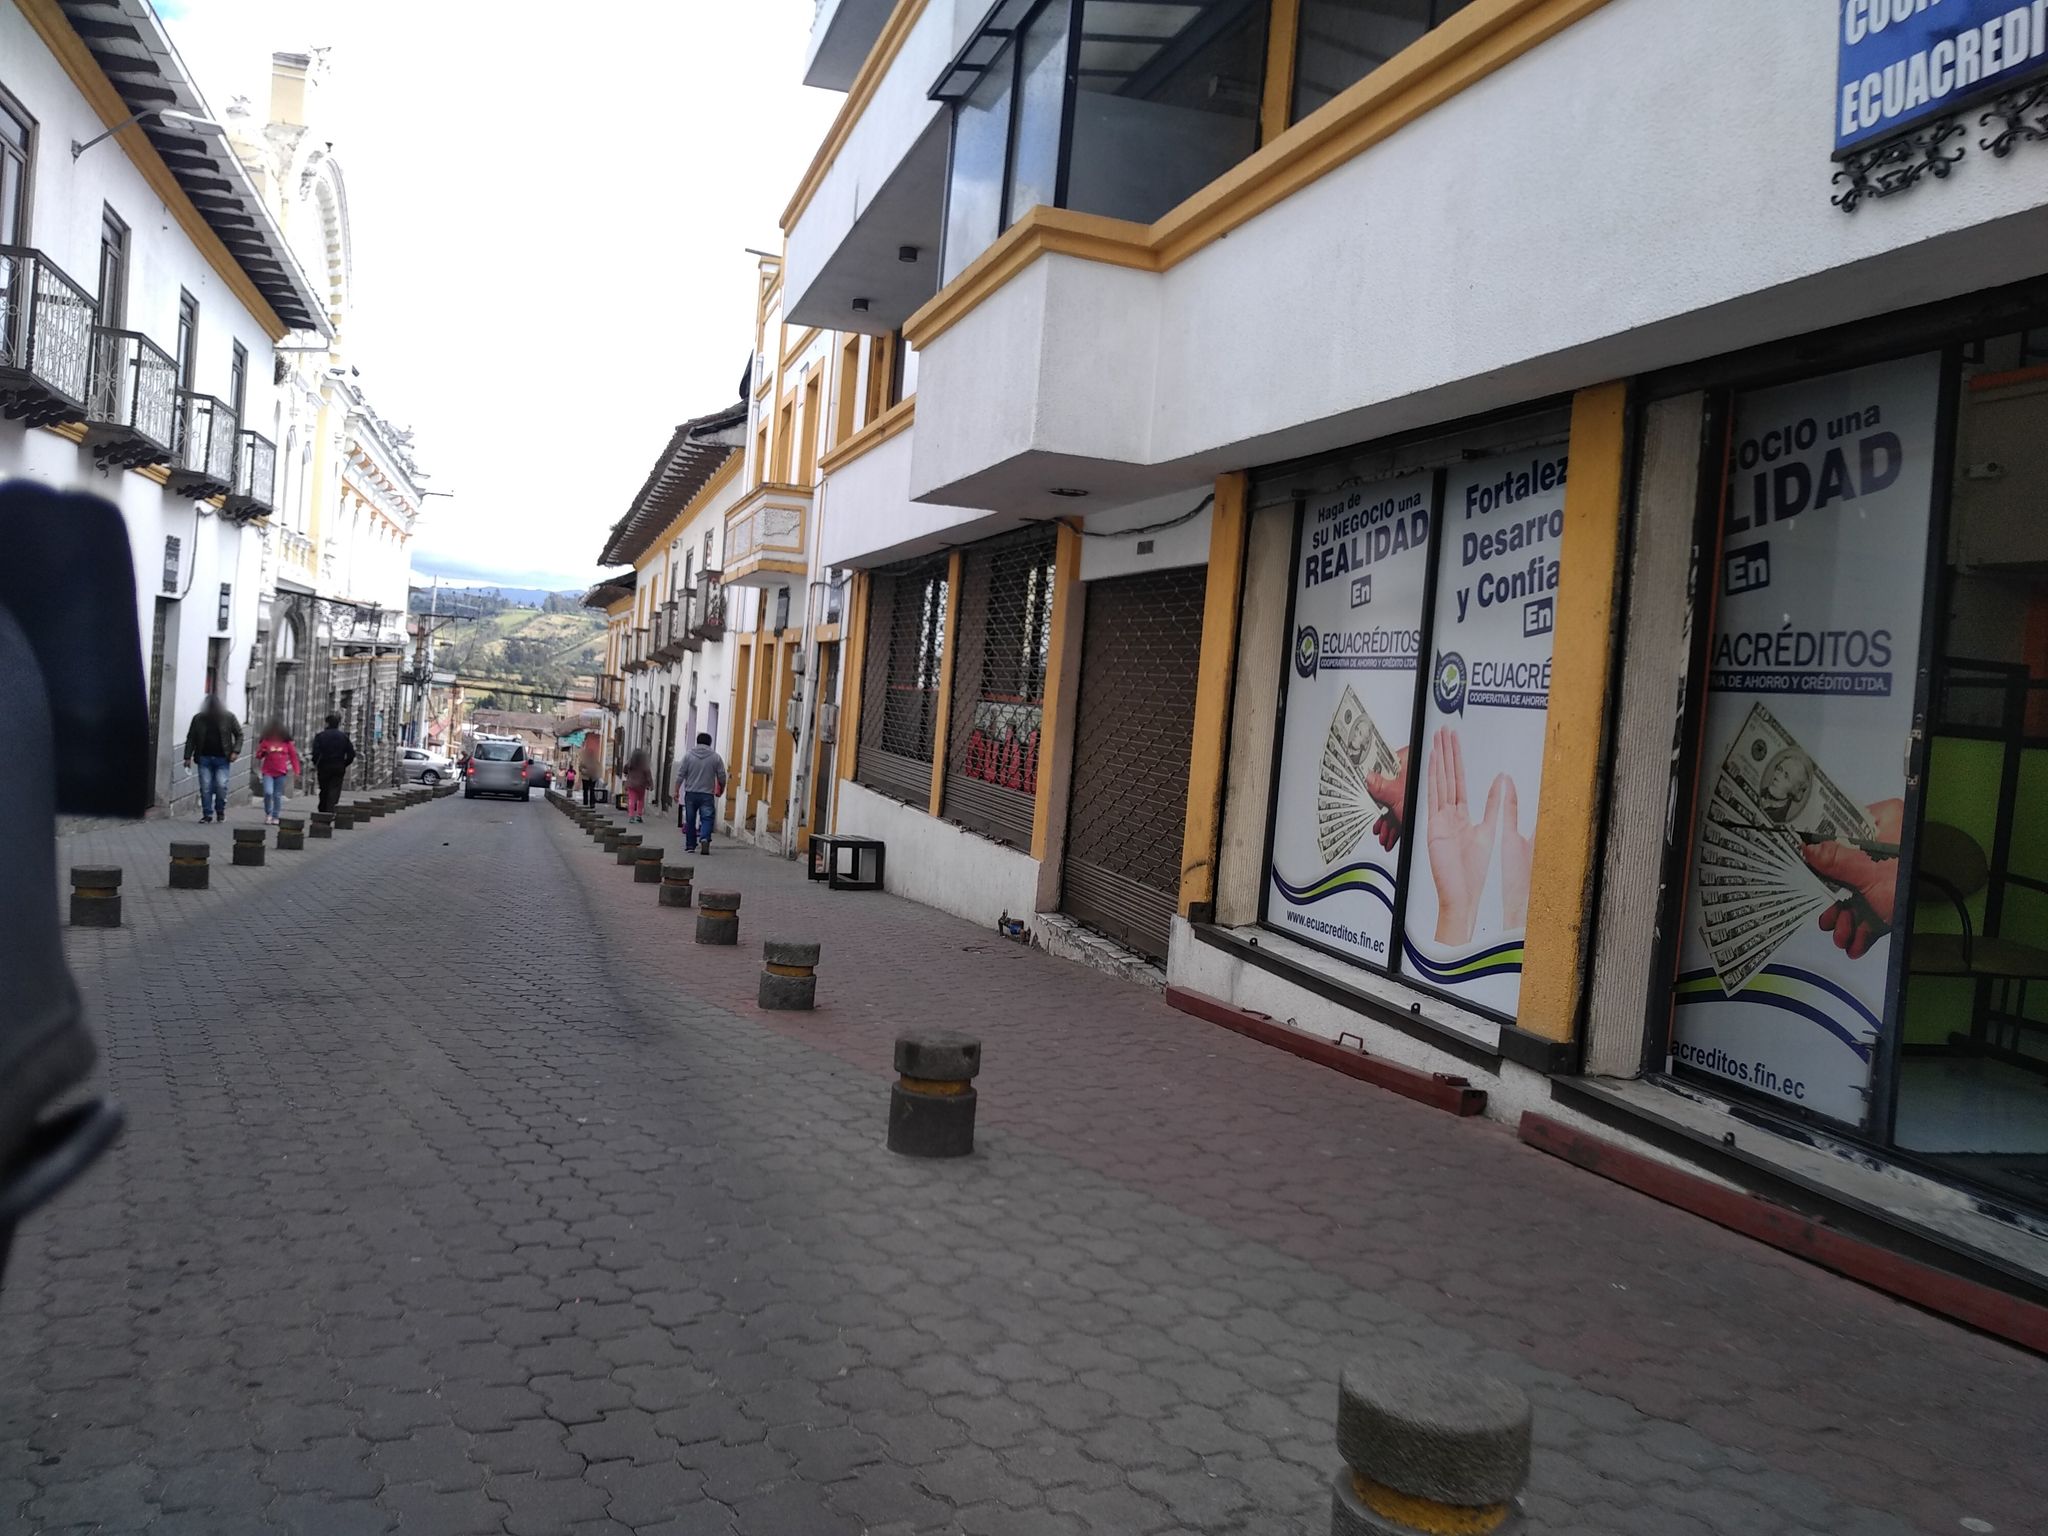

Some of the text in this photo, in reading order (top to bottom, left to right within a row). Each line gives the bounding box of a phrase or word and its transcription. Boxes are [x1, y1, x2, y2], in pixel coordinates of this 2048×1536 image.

[1828, 404, 1881, 440] una
[1312, 493, 1421, 550] SU NEGOCIO una
[1318, 492, 1361, 523] Haga de
[1305, 509, 1429, 588] REALIDAD
[1462, 509, 1564, 567] Desarro
[1456, 555, 1560, 624] y Confia
[1727, 555, 1769, 591] En
[1352, 582, 1370, 607] En
[1525, 604, 1552, 632] En
[1322, 626, 1421, 654] ECUACRÉDITOS
[1469, 692, 1511, 704] COOPERATIVA
[1511, 694, 1521, 705] DE
[1728, 675, 1743, 688] DE
[1744, 675, 1790, 689] AHORRO
[1792, 676, 1801, 688] Y
[1801, 673, 1852, 690] CRÉDITO
[1286, 908, 1385, 954] www.ecuacreditos.fin.ec
